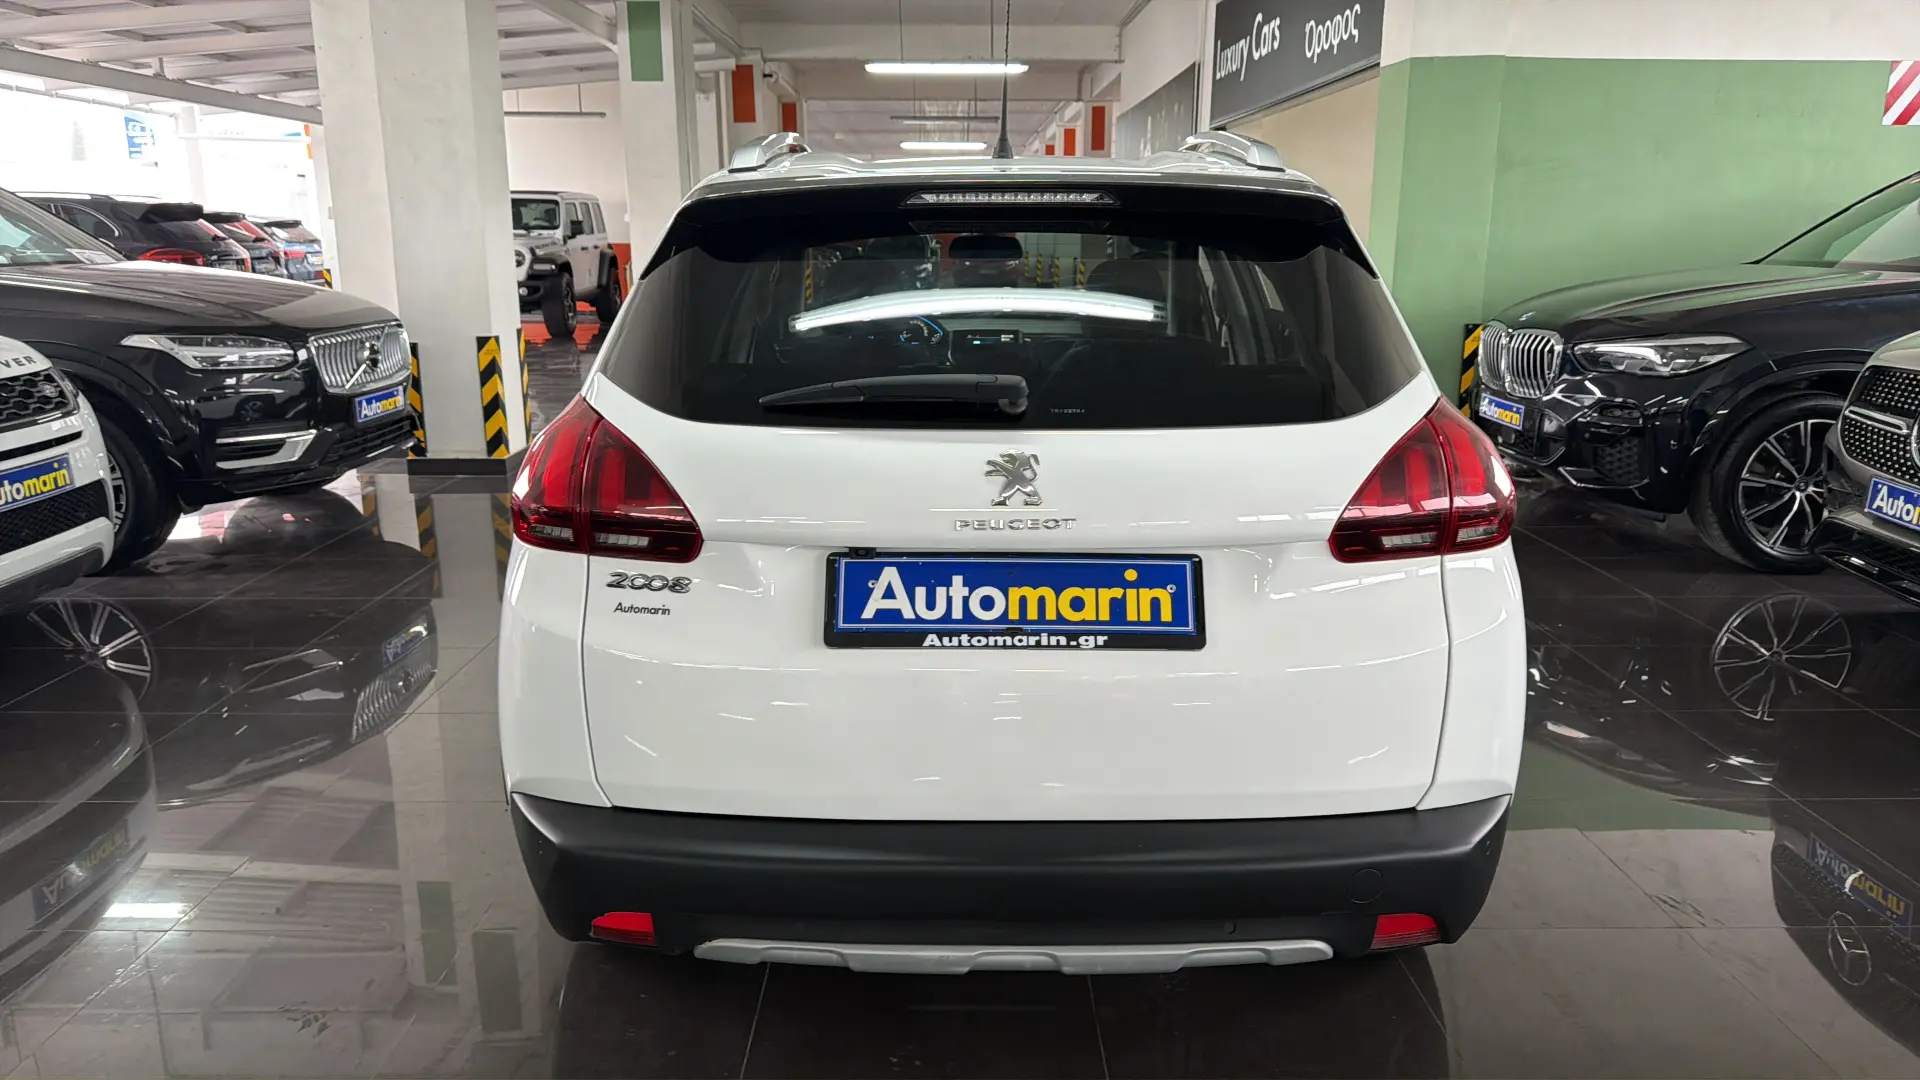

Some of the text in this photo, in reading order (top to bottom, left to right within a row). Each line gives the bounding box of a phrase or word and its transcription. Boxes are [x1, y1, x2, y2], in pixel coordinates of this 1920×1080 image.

[1305, 4, 1361, 63] Όροφος
[1215, 12, 1281, 81] Luxury Cars
[954, 518, 1077, 531] PEUGEOT
[606, 571, 693, 594] 2008
[860, 566, 1173, 622] Automarin
[613, 602, 671, 616] Automarin
[922, 633, 1109, 649] Automarin.gr
